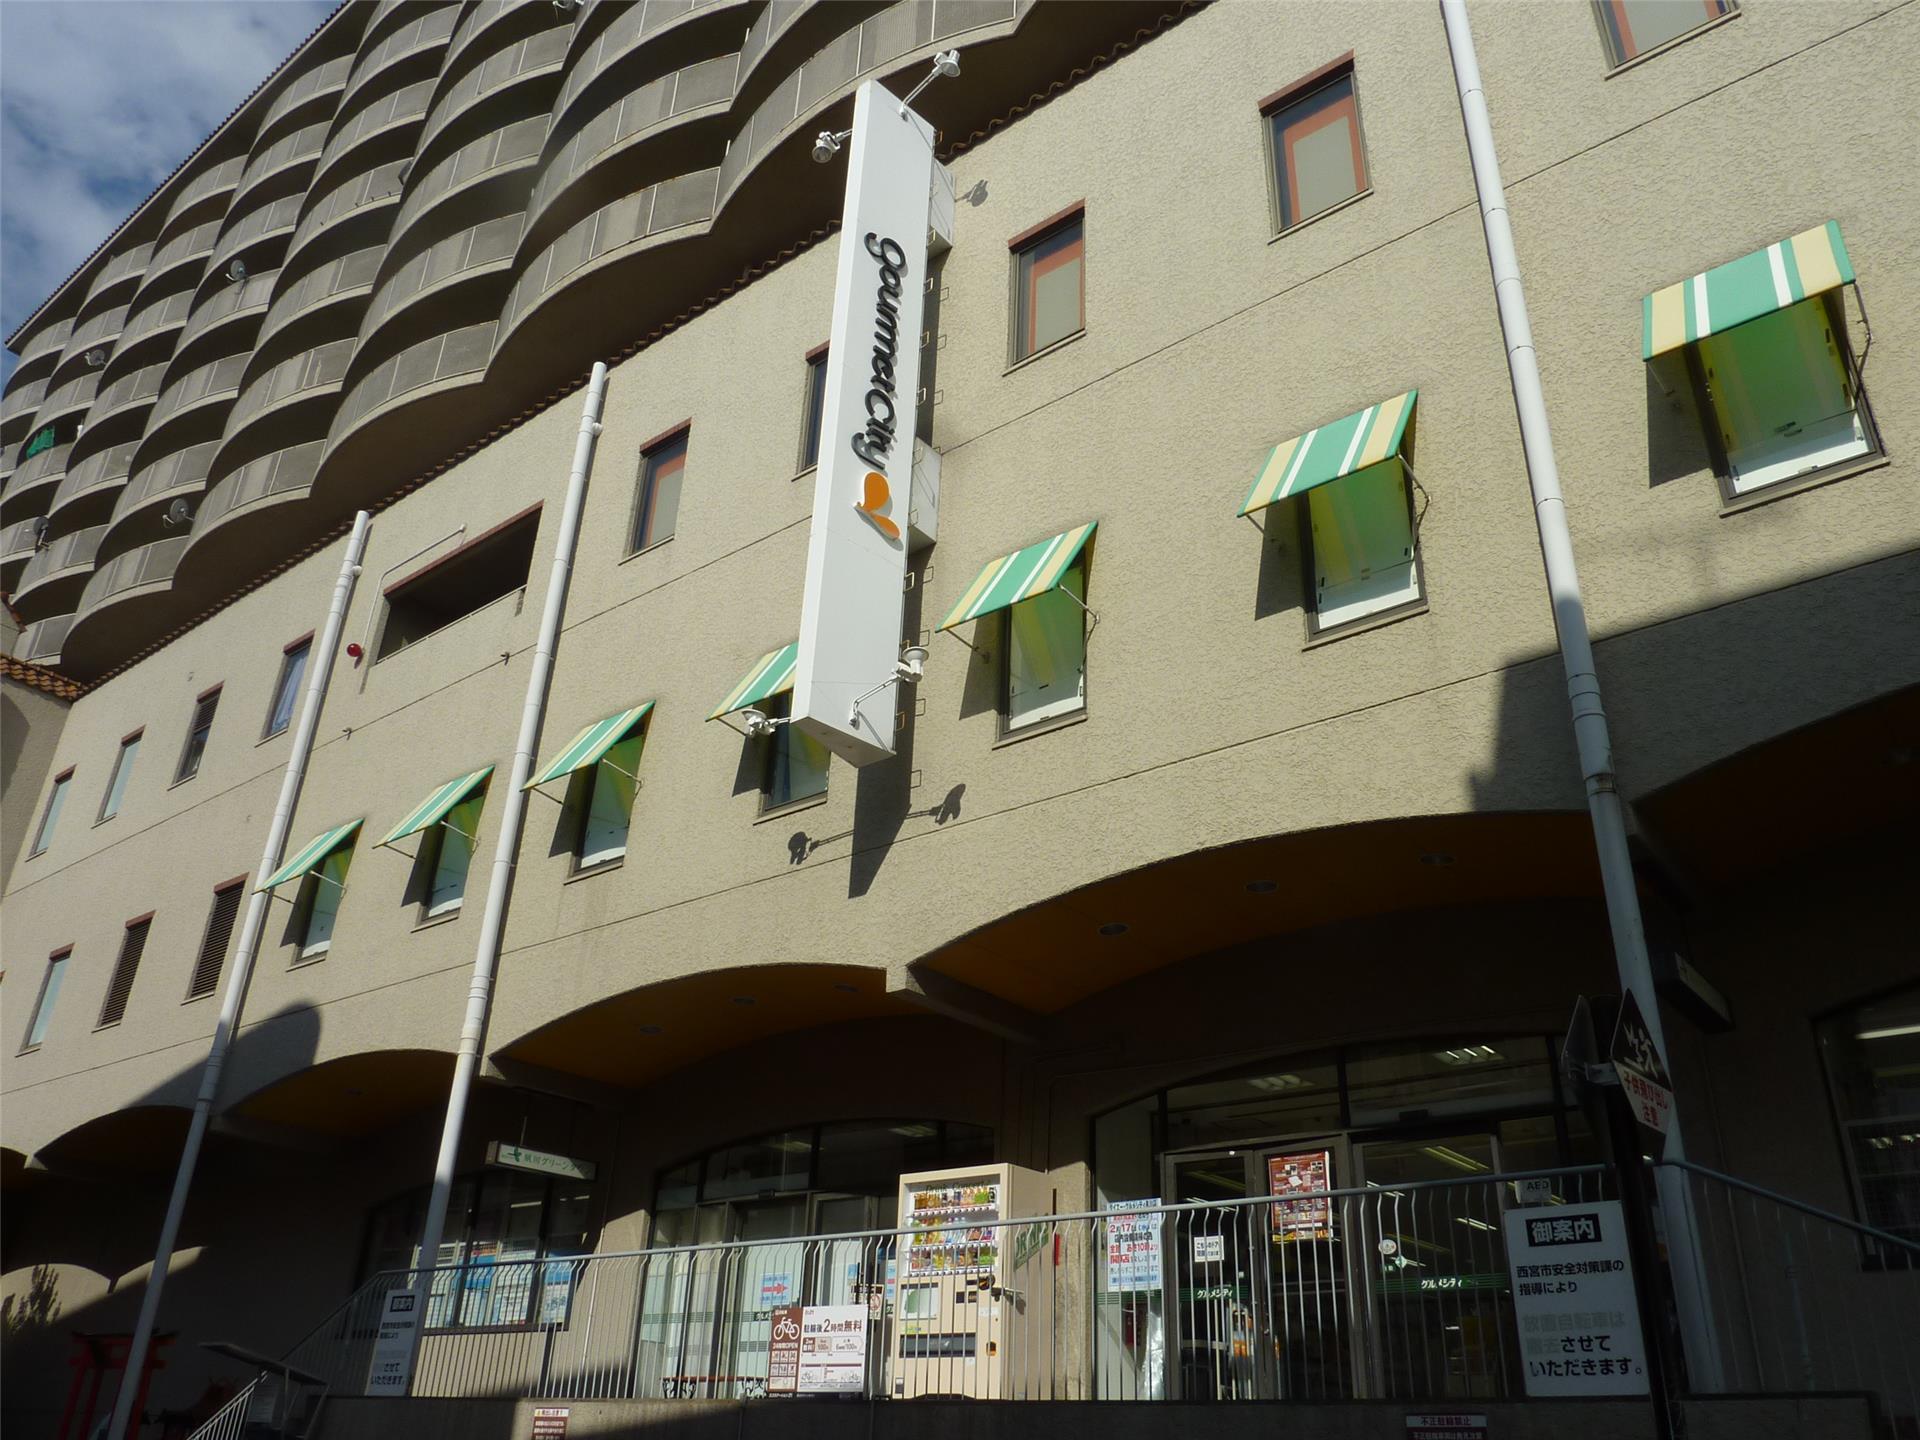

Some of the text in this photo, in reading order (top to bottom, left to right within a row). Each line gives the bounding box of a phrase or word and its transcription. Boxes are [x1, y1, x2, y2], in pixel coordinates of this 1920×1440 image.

[1641, 1101, 1659, 1127] 注意
[1531, 1218, 1597, 1244] 御案内
[1516, 1259, 1625, 1279] 西宮市安全対策課の
[1519, 1281, 1578, 1297] 指導により
[1529, 1357, 1642, 1377] いただきます。
